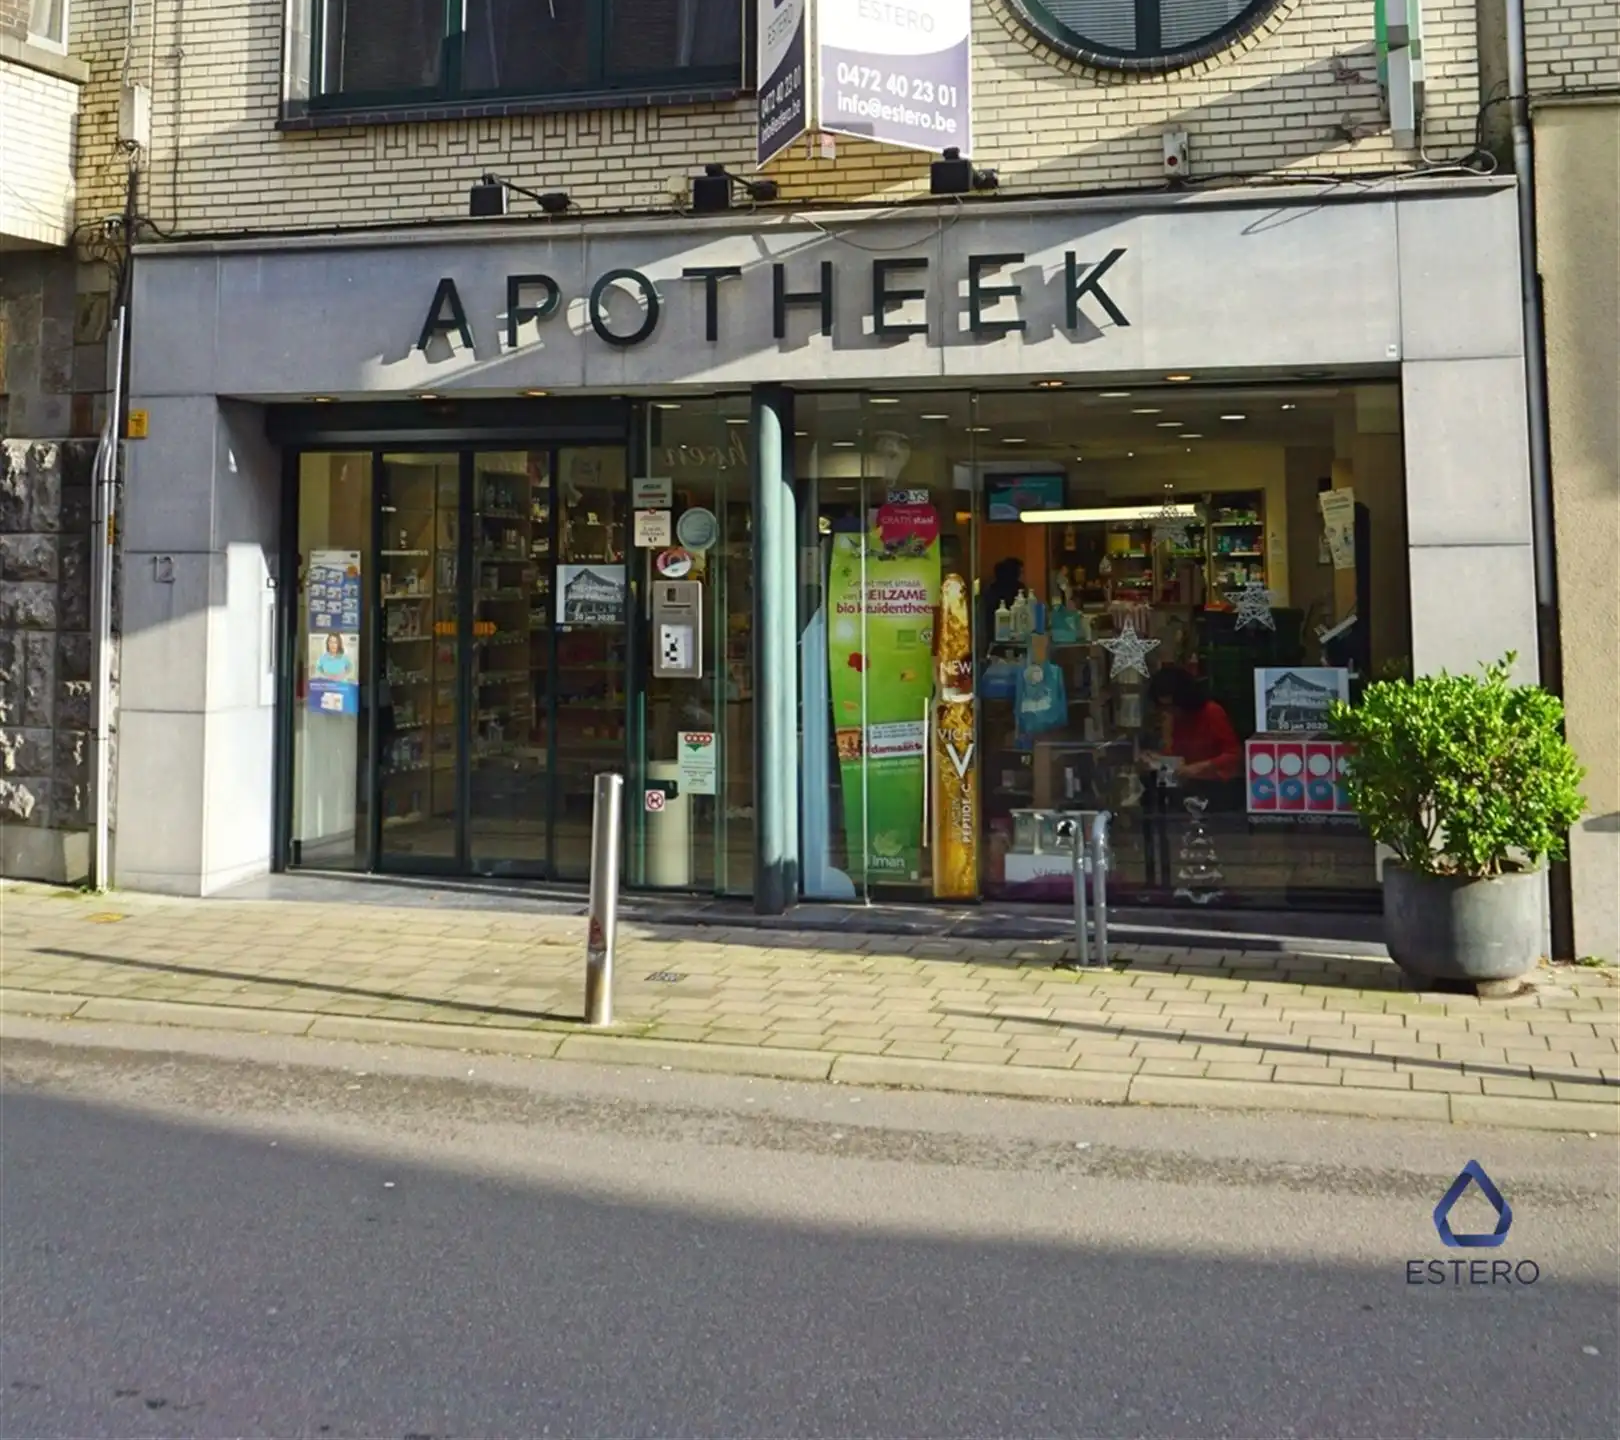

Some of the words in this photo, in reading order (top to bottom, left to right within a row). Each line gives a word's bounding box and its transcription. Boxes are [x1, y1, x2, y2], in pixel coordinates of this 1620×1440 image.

[837, 62, 880, 92] 0472
[886, 75, 908, 98] 40
[914, 79, 935, 103] 23
[938, 85, 958, 108] 01
[837, 91, 958, 134] info@estero.be
[417, 247, 1130, 351] APOTHEEK
[153, 556, 175, 583] 12
[836, 602, 855, 613] bio
[940, 661, 972, 675] NEW
[937, 728, 973, 741] VICH
